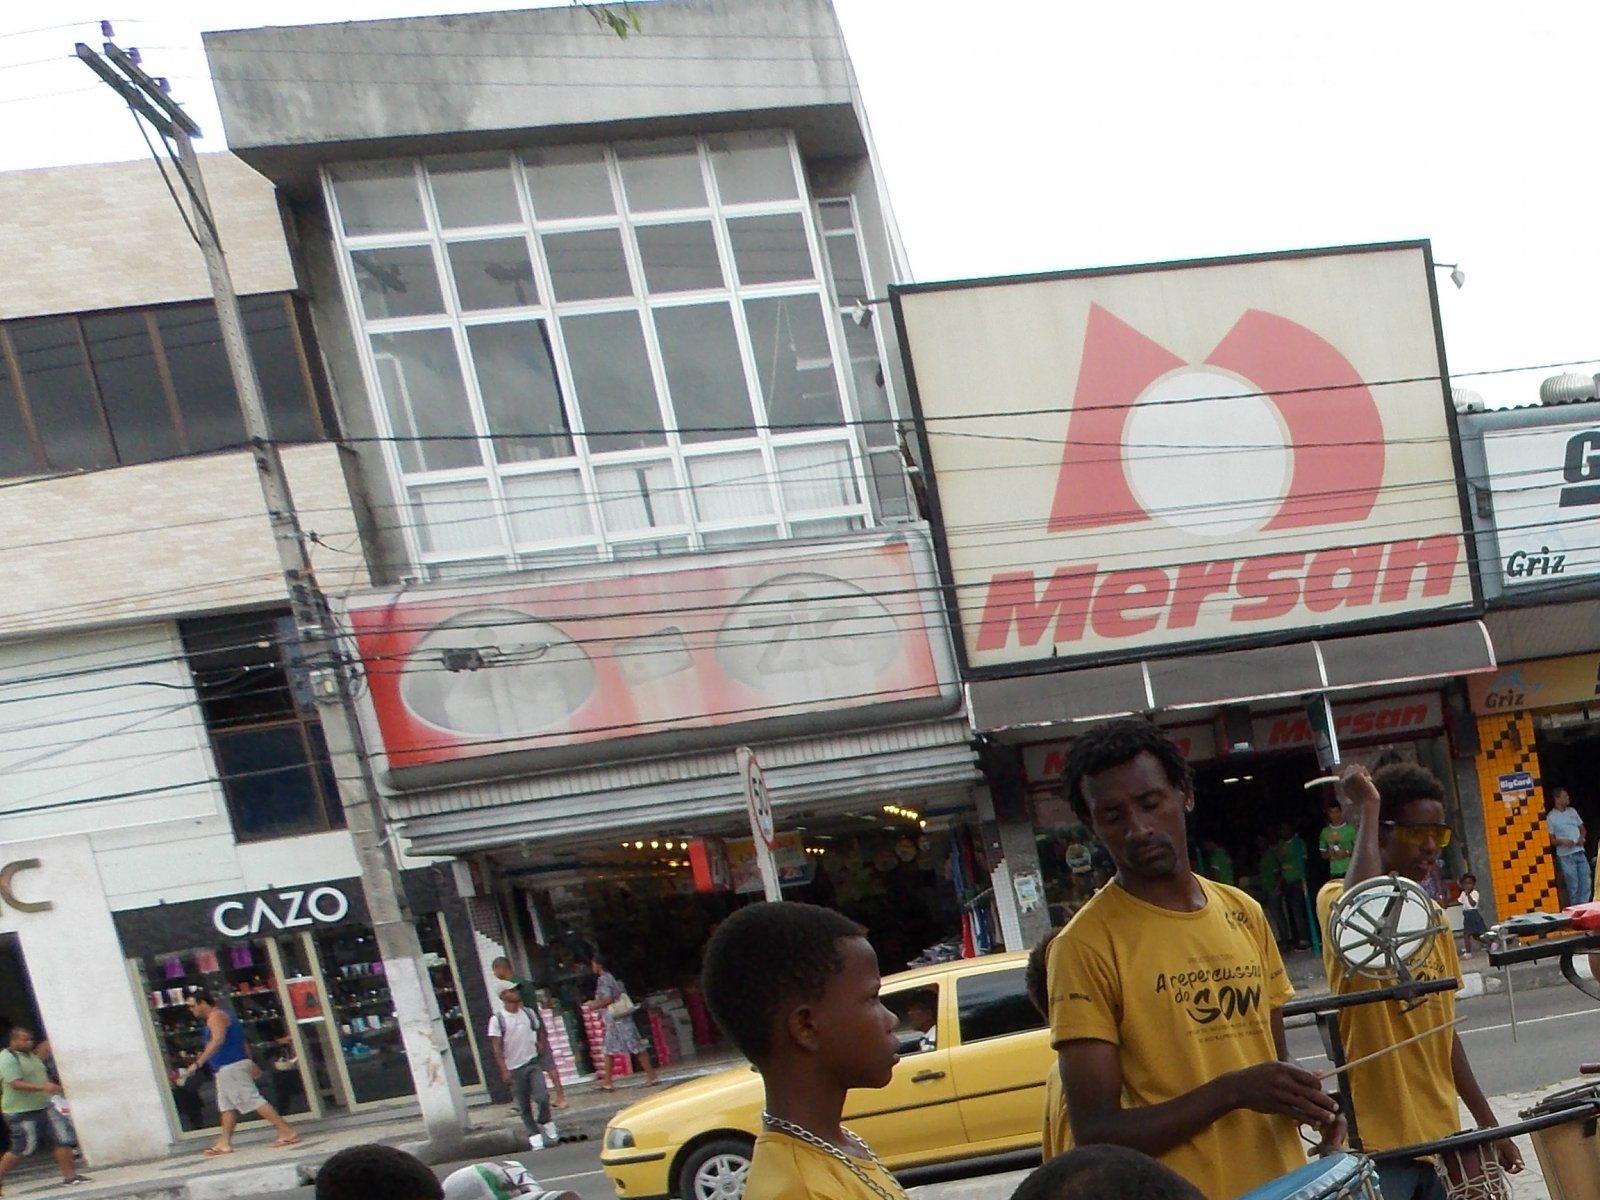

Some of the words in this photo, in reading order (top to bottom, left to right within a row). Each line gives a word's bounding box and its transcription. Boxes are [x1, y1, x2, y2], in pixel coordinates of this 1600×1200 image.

[1506, 546, 1567, 578] Griz
[975, 533, 1460, 653] Mersan
[1484, 687, 1526, 710] Griz
[1269, 702, 1428, 746] Mrsan
[1500, 775, 1532, 790] BigCard
[213, 887, 349, 938] CAZO
[1156, 973, 1167, 994] A
[1174, 987, 1191, 1004] do
